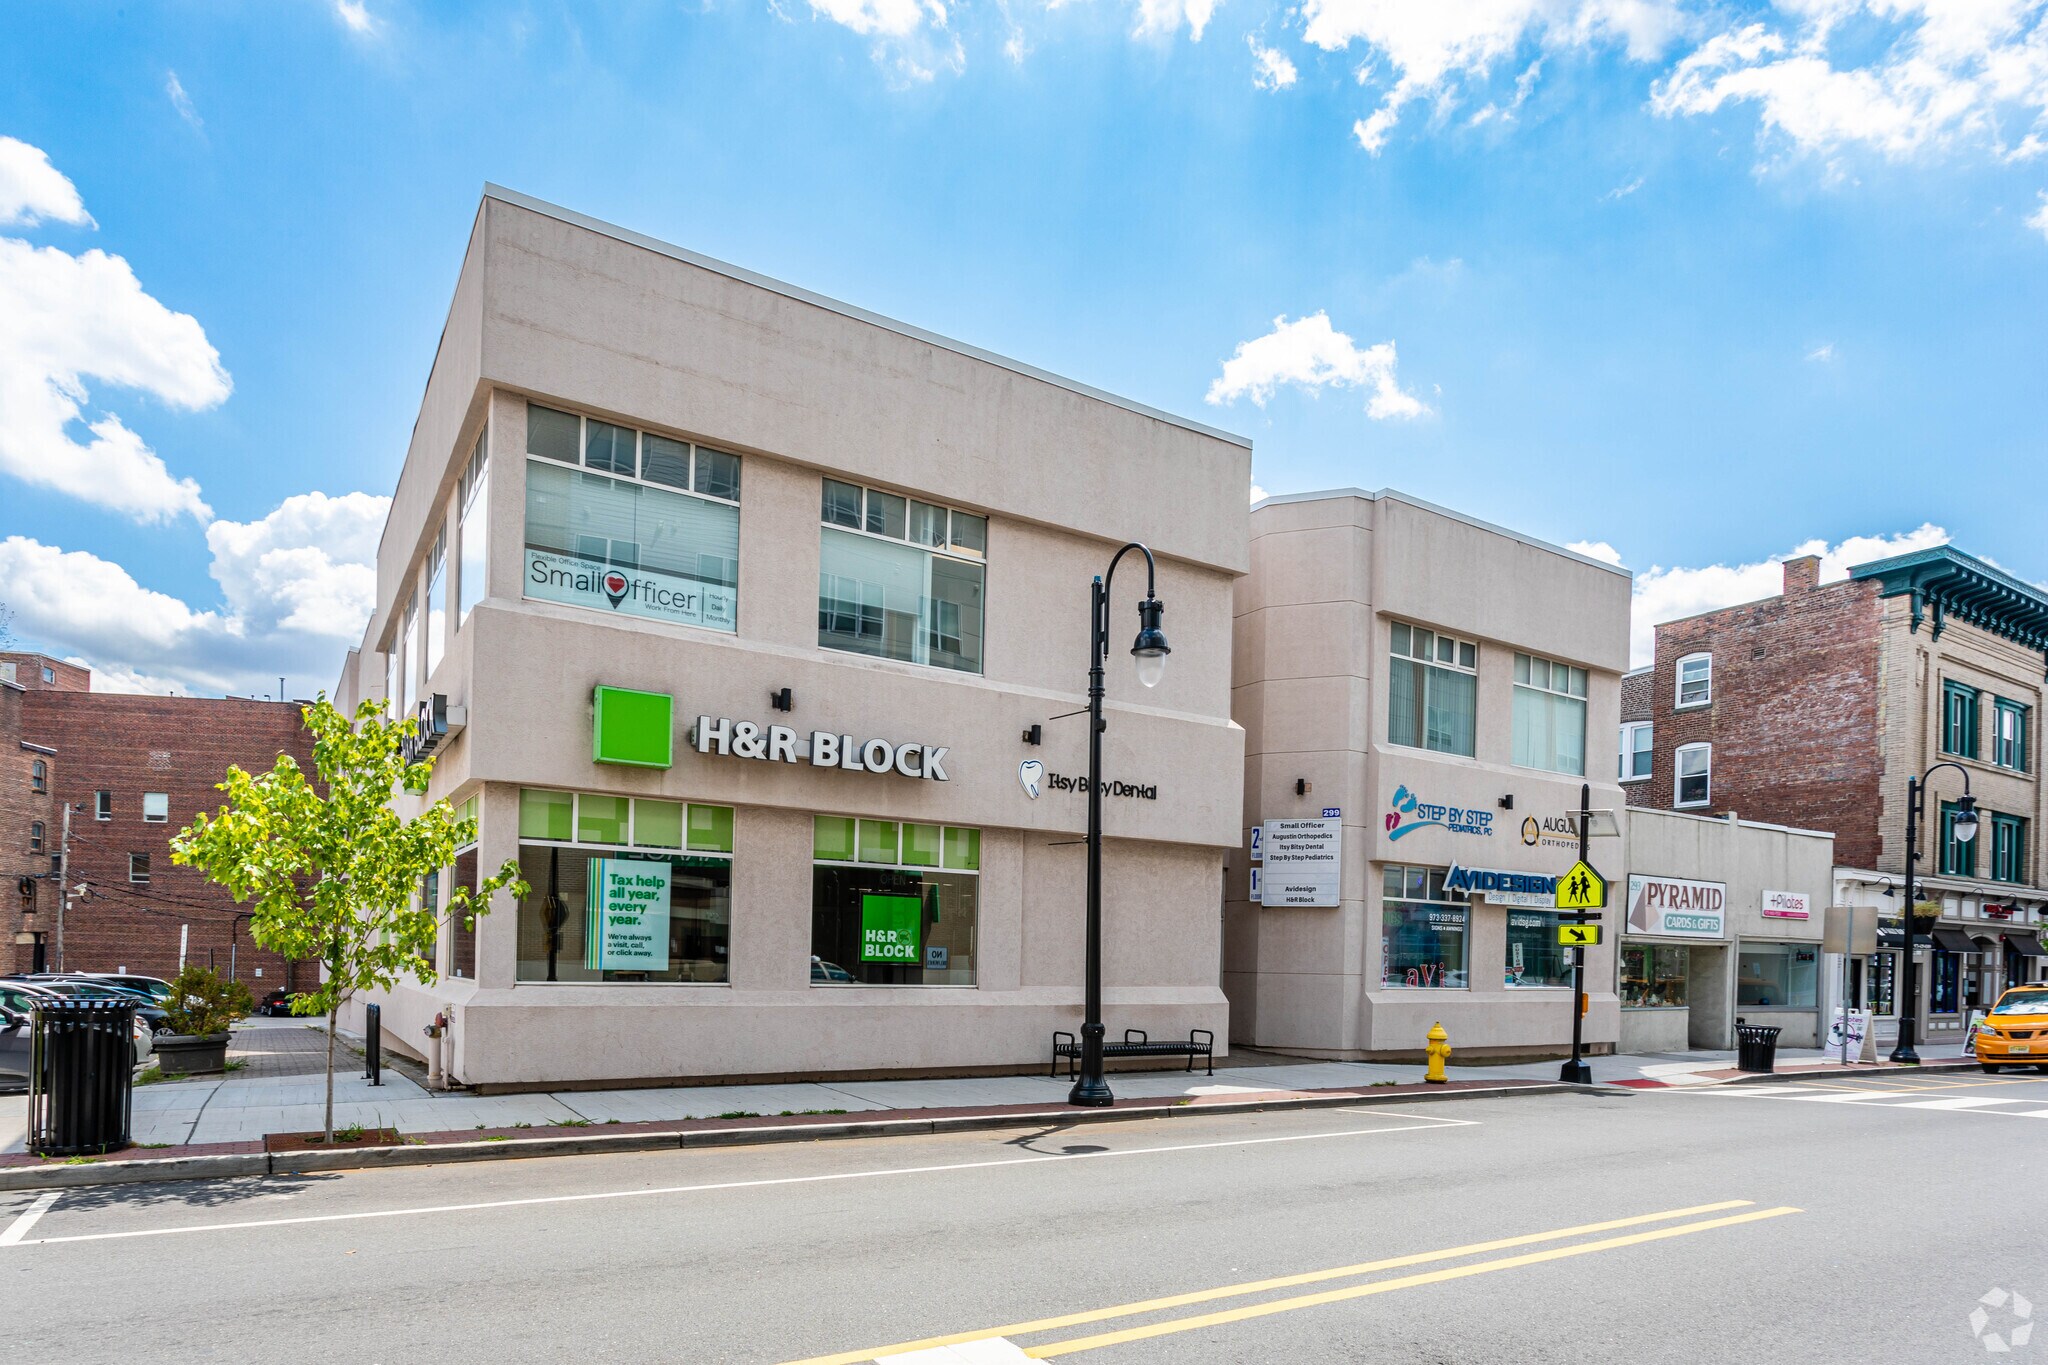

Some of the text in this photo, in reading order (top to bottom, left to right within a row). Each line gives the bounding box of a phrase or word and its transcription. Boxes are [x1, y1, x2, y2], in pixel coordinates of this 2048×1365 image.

[531, 552, 601, 571] Flexible Office Space
[645, 603, 697, 618] Work From Here
[696, 715, 950, 781] H&R BLOCK
[1048, 773, 1157, 800] Itsy Bsy Dental
[1323, 809, 1340, 817] 299
[1417, 803, 1493, 826] STEP BY STEP
[1272, 833, 1333, 841] Augustin Orthopedics
[1483, 827, 1493, 836] PC
[1541, 838, 1591, 851] ORTHOPEDS
[1270, 853, 1334, 862] Step By Step Pediatrics
[609, 874, 665, 889] Tax help
[1447, 865, 1556, 894] AVIDESIGN
[1630, 881, 1641, 891] 293
[609, 887, 660, 901] all year,
[1488, 892, 1552, 905] Design Digital Display
[1647, 883, 1722, 910] PYRAMID
[608, 902, 647, 914] every
[608, 915, 641, 926] year.
[1666, 916, 1692, 928] CARDS
[1697, 918, 1719, 930] GIFTS
[865, 929, 897, 943] H&R
[613, 941, 629, 949] visit,
[865, 944, 915, 958] BLOCK
[1406, 962, 1445, 988] avi
